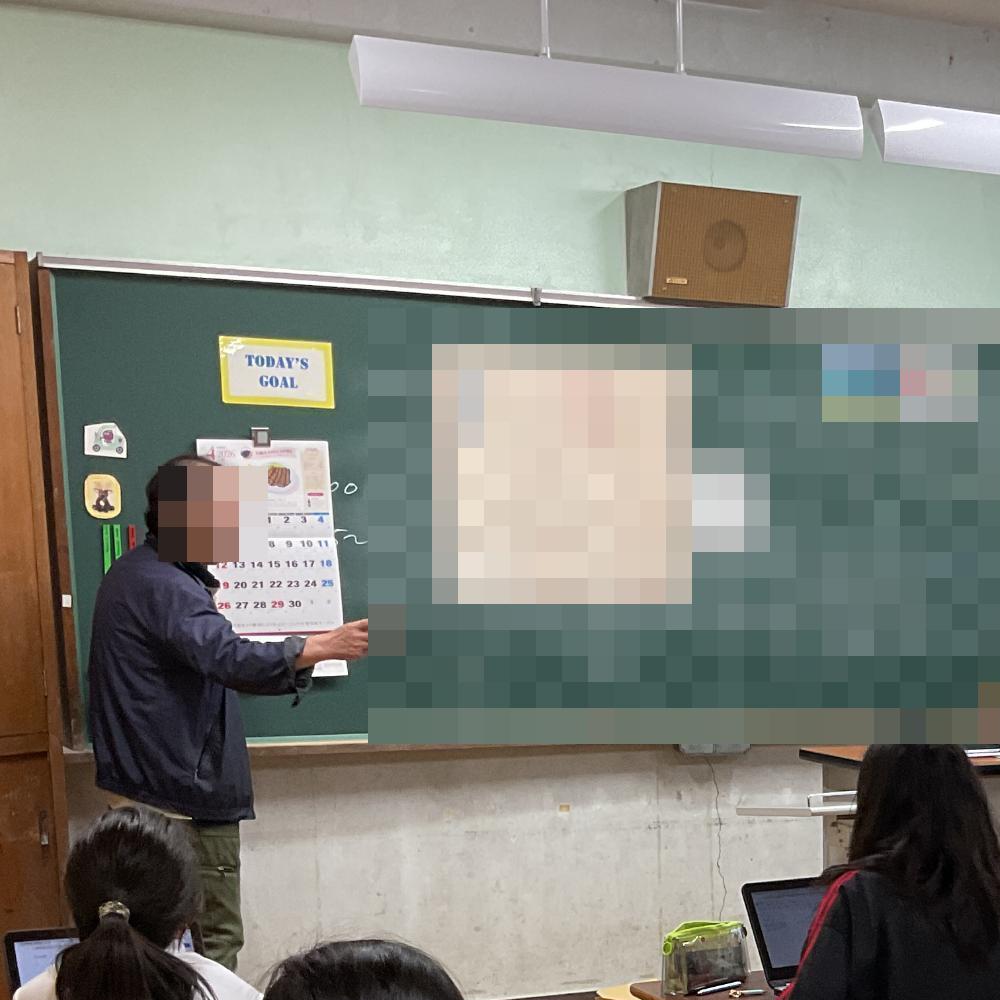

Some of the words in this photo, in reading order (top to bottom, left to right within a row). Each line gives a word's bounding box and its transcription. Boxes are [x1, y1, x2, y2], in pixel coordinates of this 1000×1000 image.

[245, 354, 309, 370] TODAY'S
[259, 375, 298, 389] GOAL
[286, 540, 293, 548] 9
[268, 560, 281, 568] 15
[286, 560, 298, 568] 16
[234, 581, 247, 589] 20
[287, 580, 300, 588] 23
[253, 601, 266, 609] 28
[289, 600, 302, 608] 30
